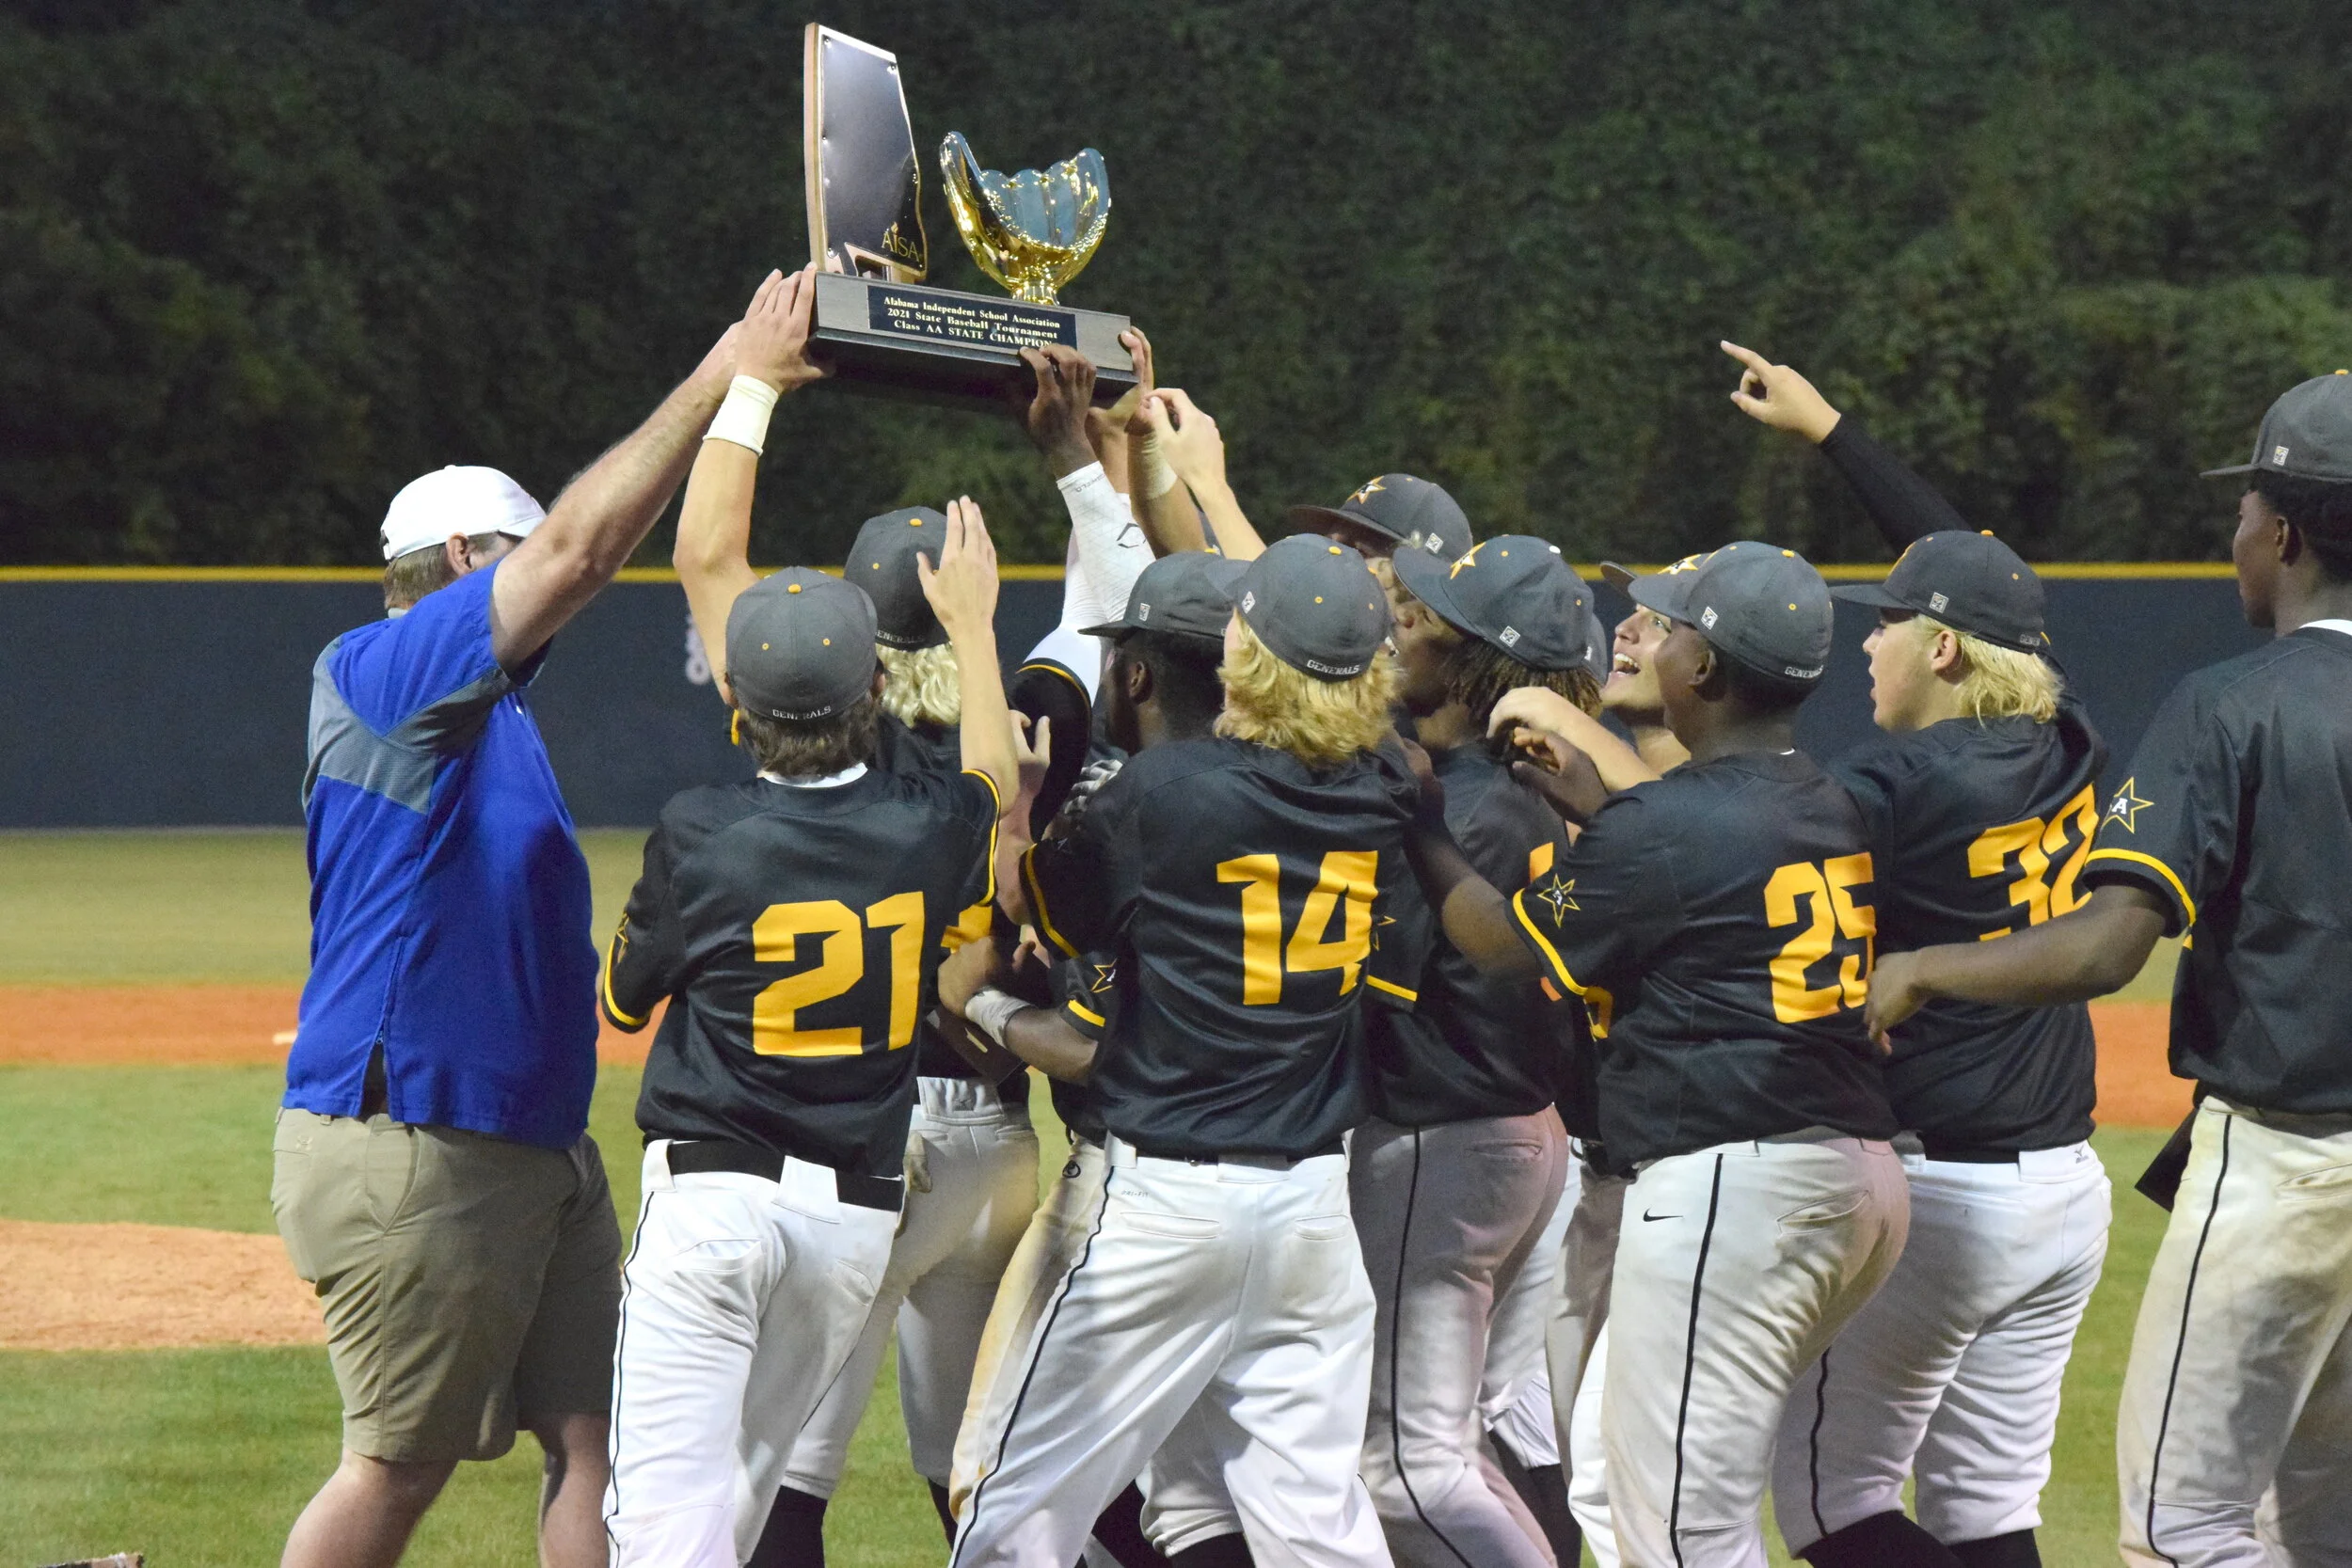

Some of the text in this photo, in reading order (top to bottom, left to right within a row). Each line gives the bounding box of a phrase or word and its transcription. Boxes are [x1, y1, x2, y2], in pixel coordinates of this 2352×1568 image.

[882, 230, 920, 262] AISA
[884, 296, 1060, 328] Alabama Independent School Association
[887, 308, 1057, 339] 2021 State Baseball Tournament
[894, 320, 920, 331] Class
[926, 324, 943, 334] AA
[948, 327, 984, 340] STATE
[875, 629, 924, 643] ENERALS
[1307, 659, 1360, 675] GENERALS
[2111, 797, 2128, 815] A
[1967, 782, 2099, 941] 32
[1216, 850, 1378, 1005] 14
[1764, 851, 1877, 1023] 25
[753, 891, 925, 1056] 21
